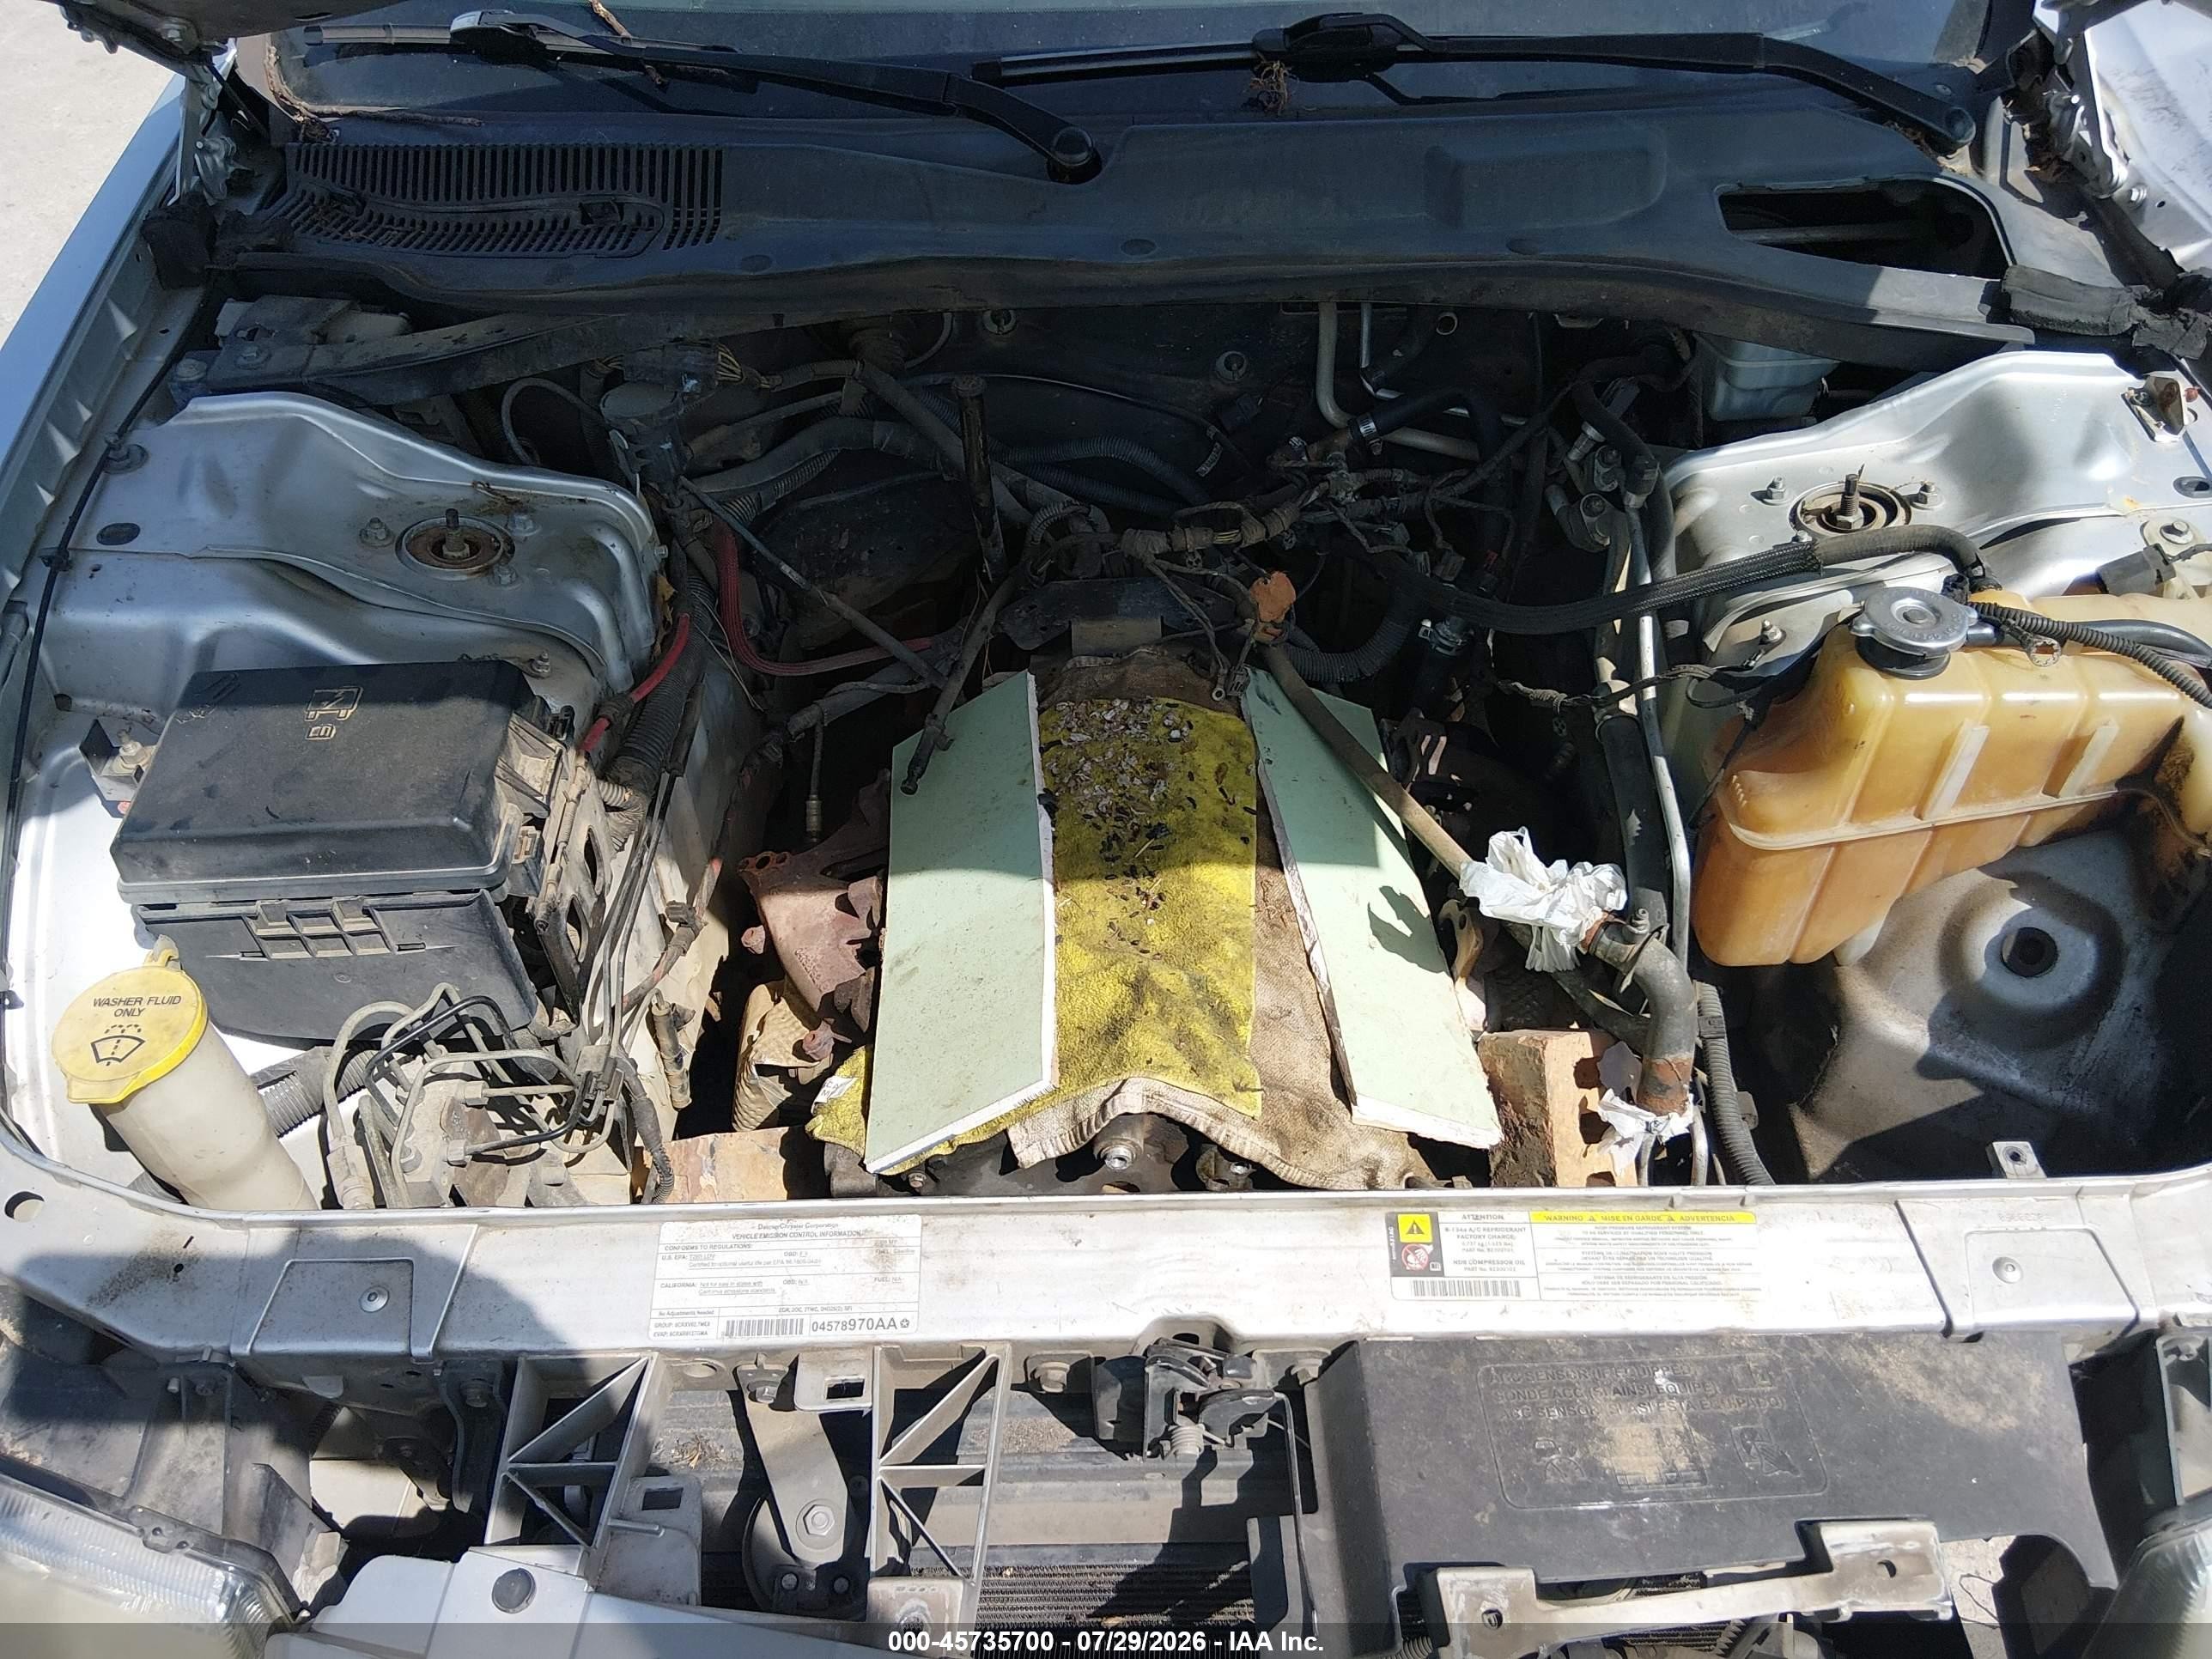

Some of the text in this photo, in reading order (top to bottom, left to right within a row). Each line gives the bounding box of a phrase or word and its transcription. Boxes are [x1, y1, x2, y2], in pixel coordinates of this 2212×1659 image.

[93, 995, 182, 1007] WASHER FLUID
[114, 1007, 145, 1018] ONLY
[811, 1317, 897, 1332] 04578970AA
[1524, 1369, 1589, 1382] SENSOR
[1614, 1364, 1696, 1379] EQUIPPED
[1496, 1388, 1548, 1401] SONDE
[1552, 1386, 1585, 1400] ACC
[1612, 1383, 1651, 1398] AINSI
[1502, 1406, 1533, 1420] ACC
[1537, 1404, 1598, 1419] SENSOR
[1629, 1400, 1653, 1415] ASI
[1656, 1398, 1696, 1413] ESTA
